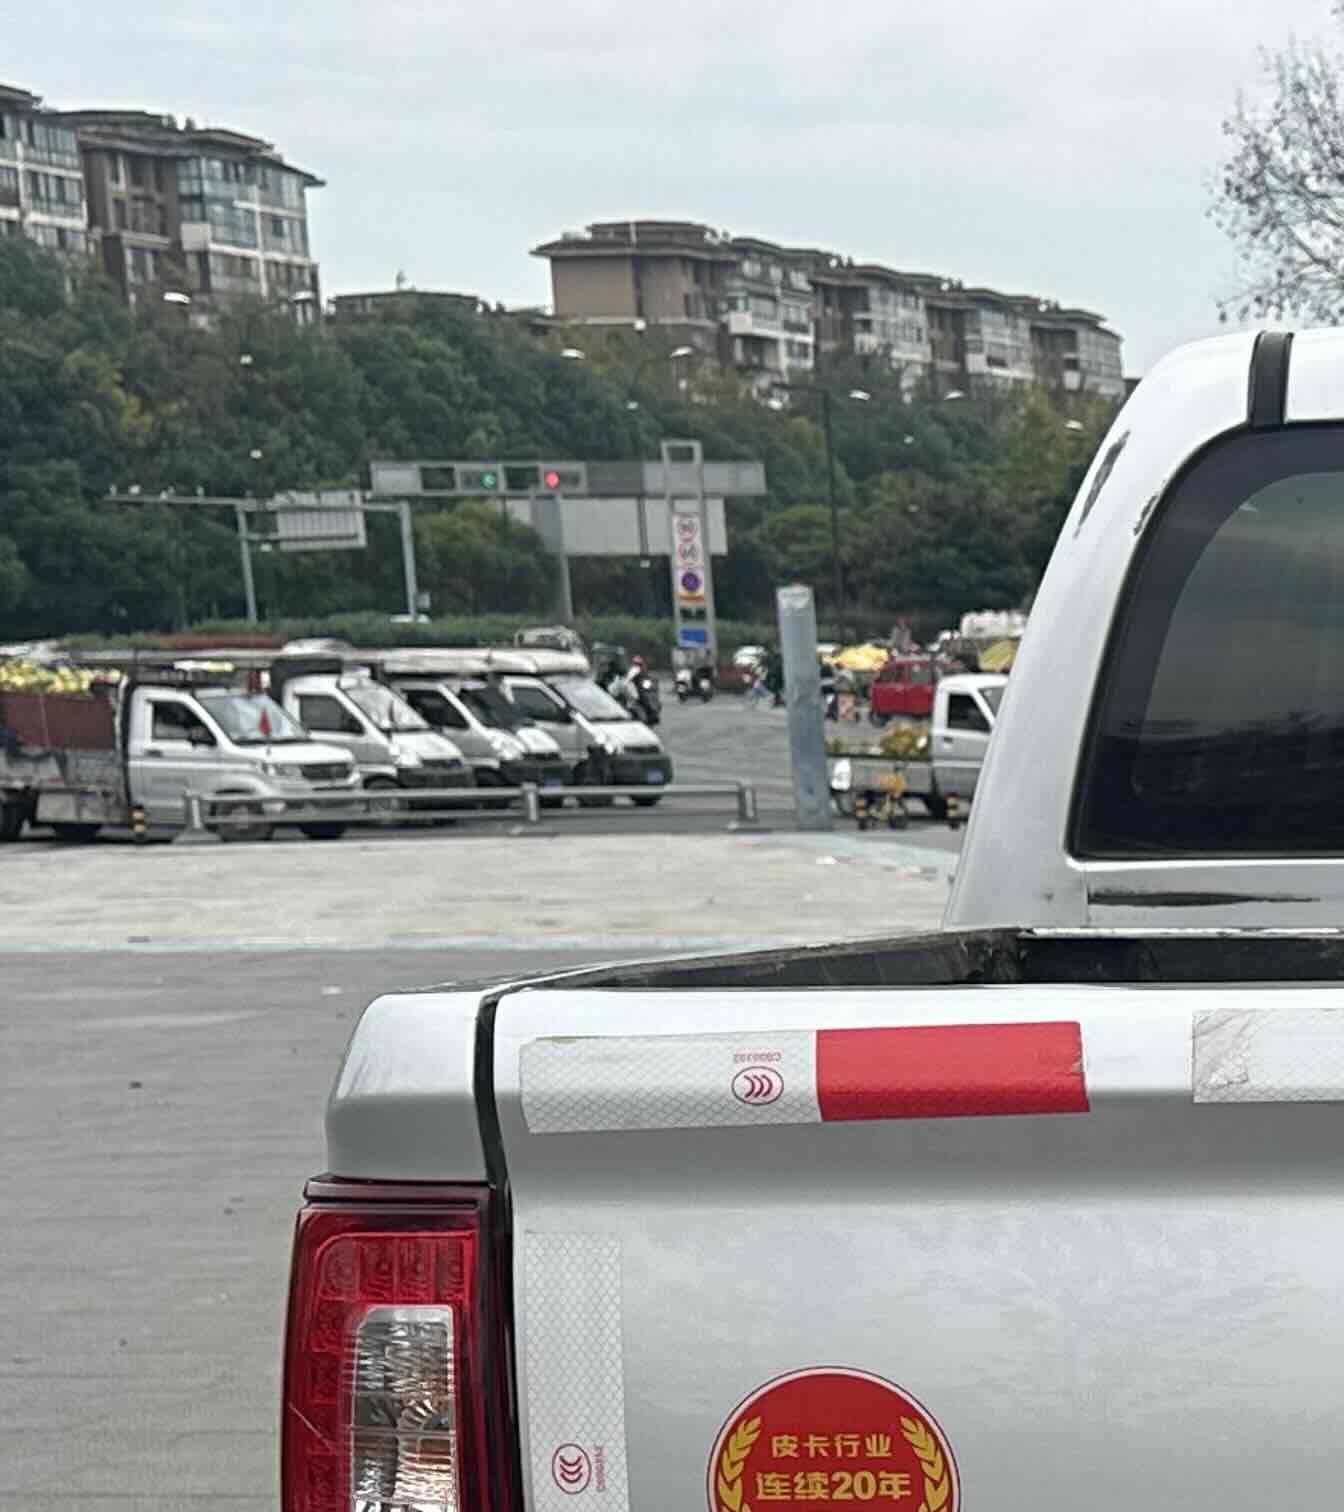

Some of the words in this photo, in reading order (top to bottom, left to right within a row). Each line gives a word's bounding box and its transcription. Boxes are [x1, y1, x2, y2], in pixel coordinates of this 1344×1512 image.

[771, 1434, 892, 1458] 皮卡行业
[756, 1471, 912, 1501] 连续20年
